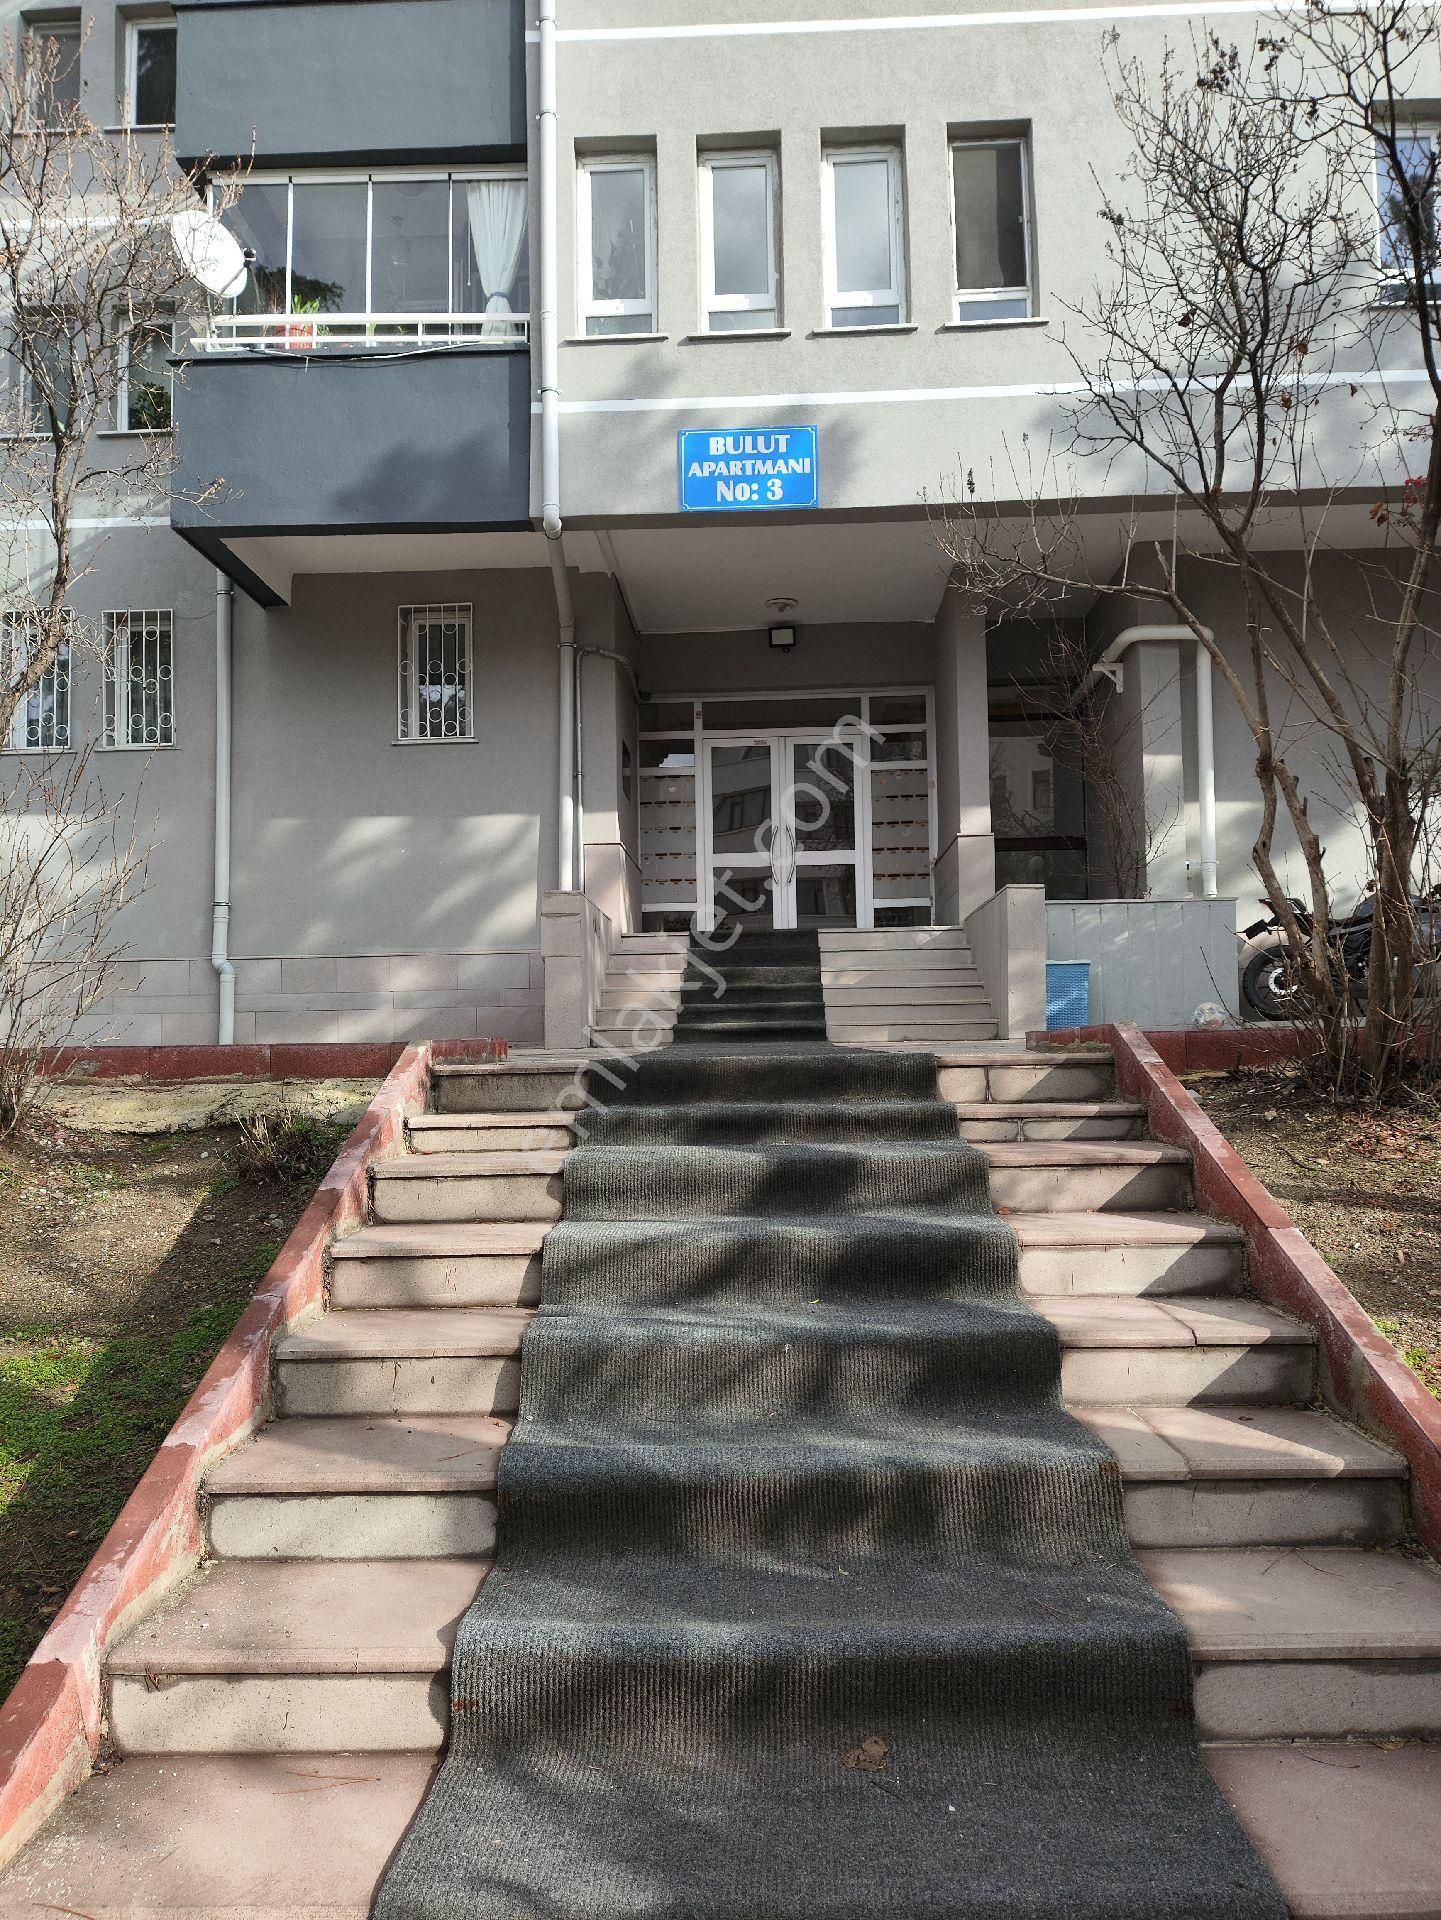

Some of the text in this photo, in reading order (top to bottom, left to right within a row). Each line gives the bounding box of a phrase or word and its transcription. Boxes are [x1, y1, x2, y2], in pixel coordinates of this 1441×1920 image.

[709, 435, 790, 455] BULUT
[688, 458, 811, 477] APARTMANI
[716, 478, 784, 502] No: 3
